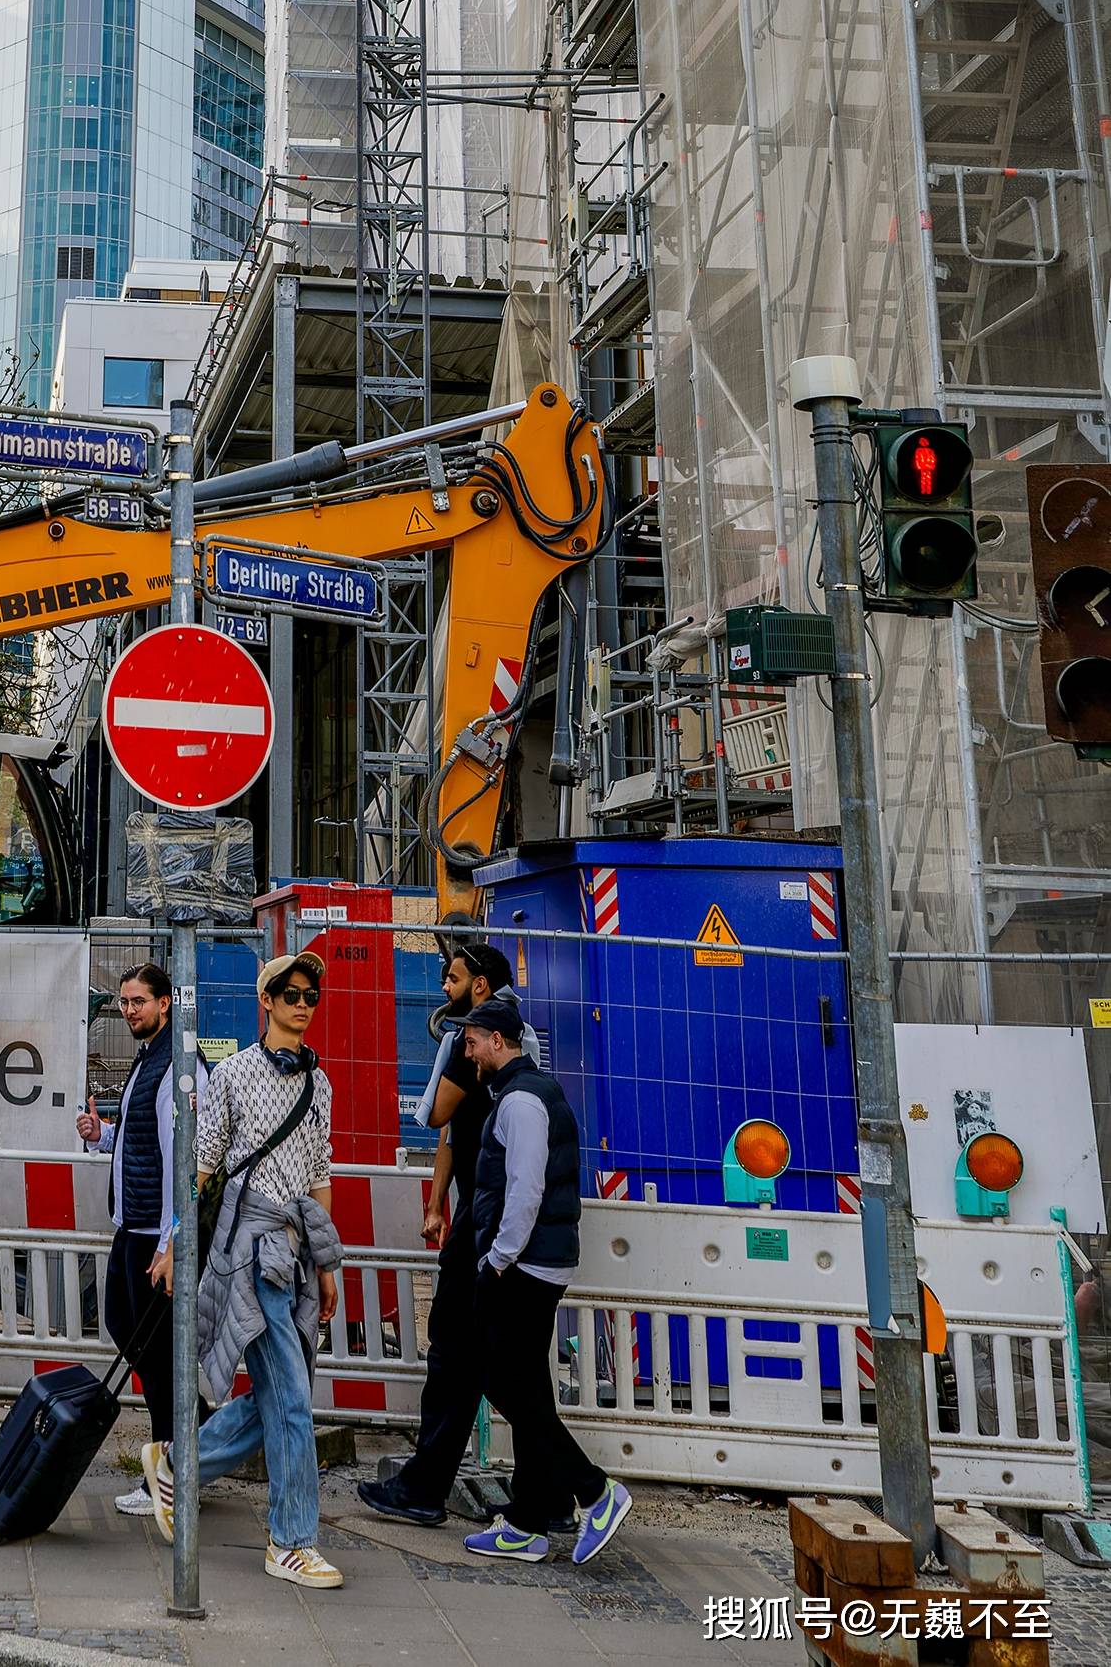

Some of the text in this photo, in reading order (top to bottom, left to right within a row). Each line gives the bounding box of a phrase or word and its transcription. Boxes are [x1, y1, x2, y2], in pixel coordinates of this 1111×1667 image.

[88, 498, 140, 521] 58-50
[228, 557, 299, 595] Berliner
[308, 571, 365, 605] Straße
[217, 615, 265, 641] 72-62
[334, 946, 368, 961] A630
